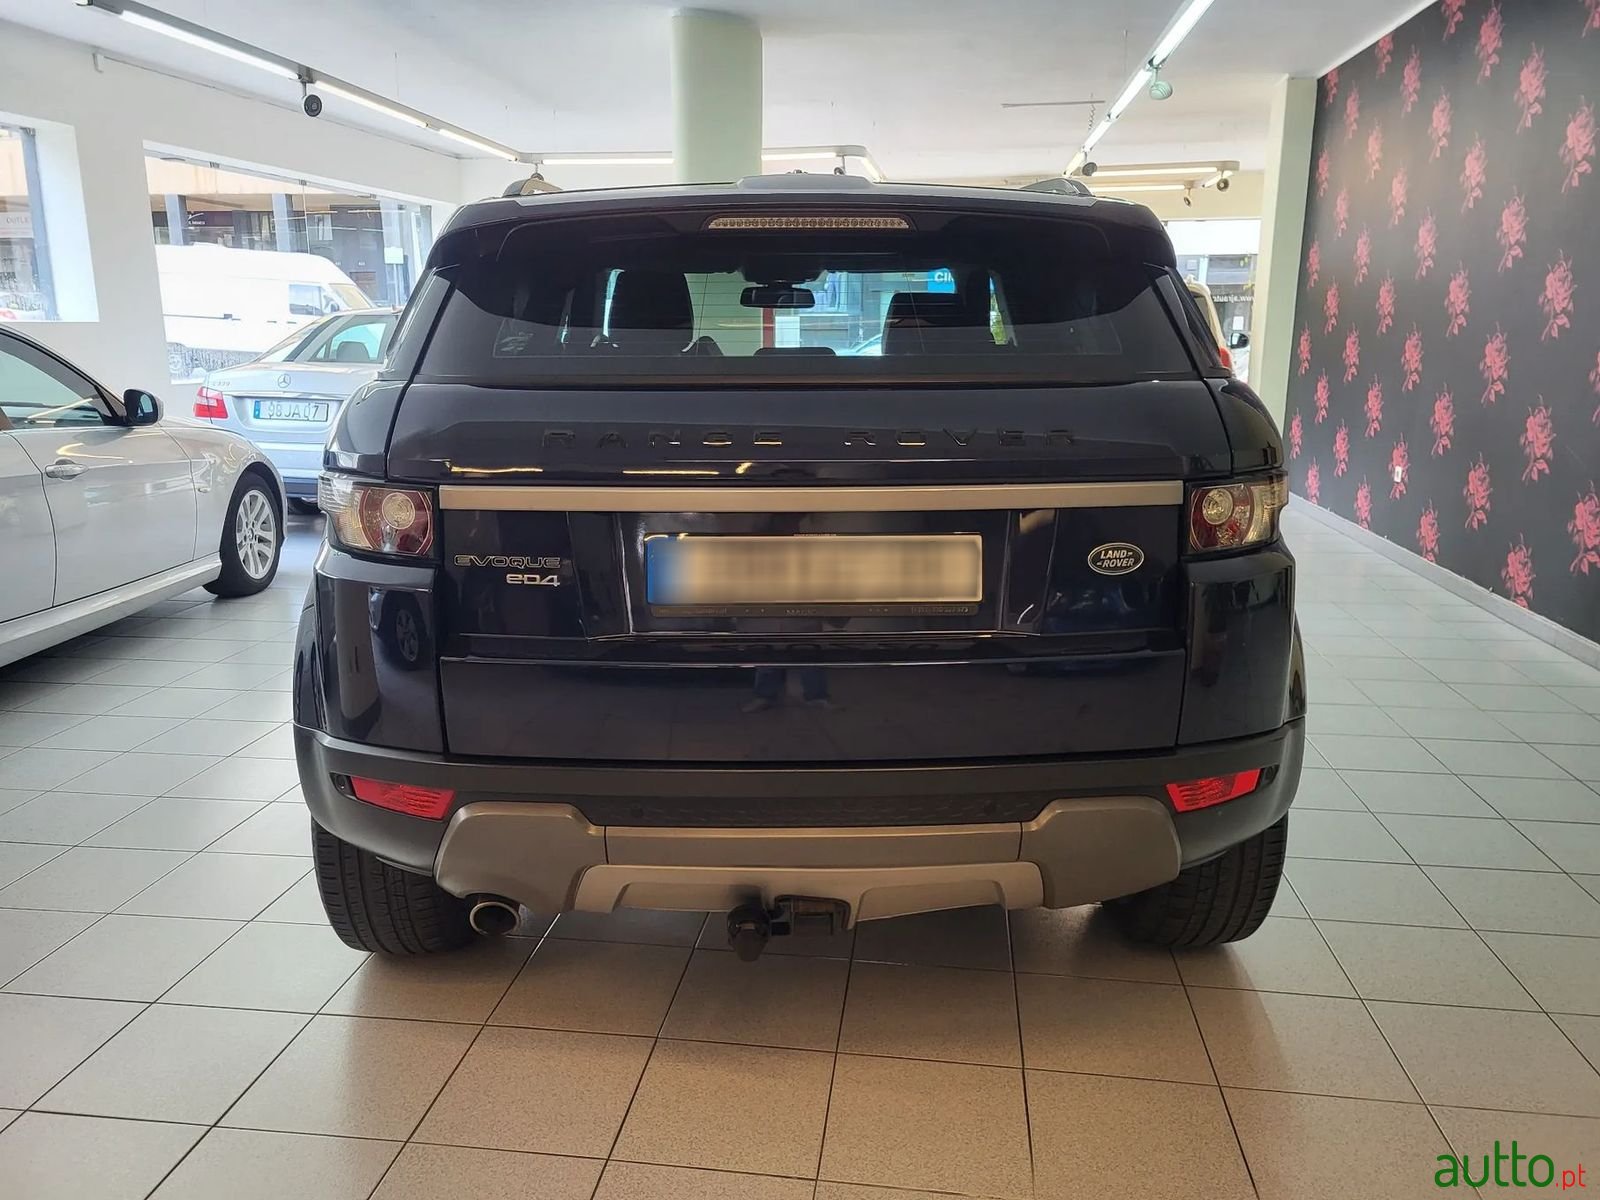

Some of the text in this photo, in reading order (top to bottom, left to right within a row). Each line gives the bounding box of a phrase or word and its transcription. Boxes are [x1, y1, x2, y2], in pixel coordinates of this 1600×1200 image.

[284, 404, 300, 419] JA
[542, 427, 1074, 447] RANGE ROVER
[454, 555, 560, 569] EVOQUE
